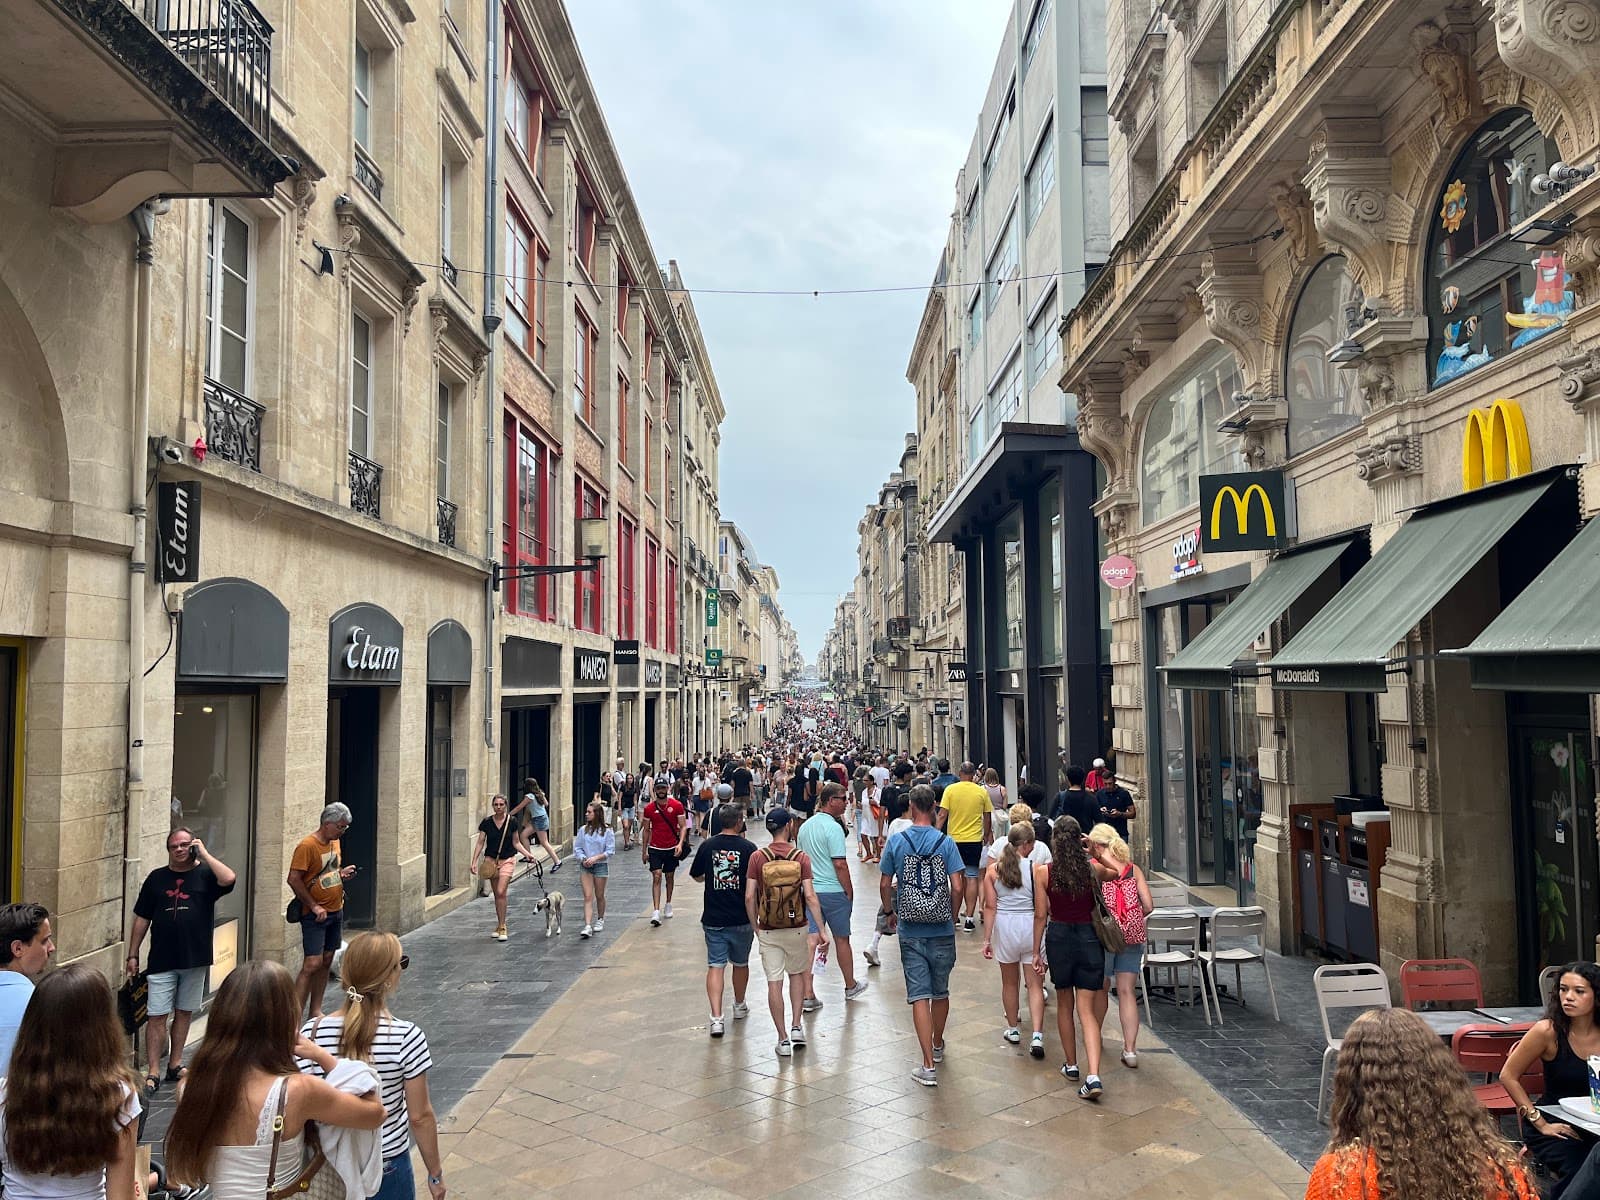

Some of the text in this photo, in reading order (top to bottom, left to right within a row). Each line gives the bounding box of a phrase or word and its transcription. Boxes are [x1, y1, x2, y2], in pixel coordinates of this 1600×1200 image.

[166, 487, 189, 577] Etam
[1103, 566, 1129, 576] adopt
[346, 626, 400, 670] Etam
[580, 655, 607, 681] MANGO
[948, 669, 966, 680] ZARA
[1276, 669, 1320, 683] McDonald's
